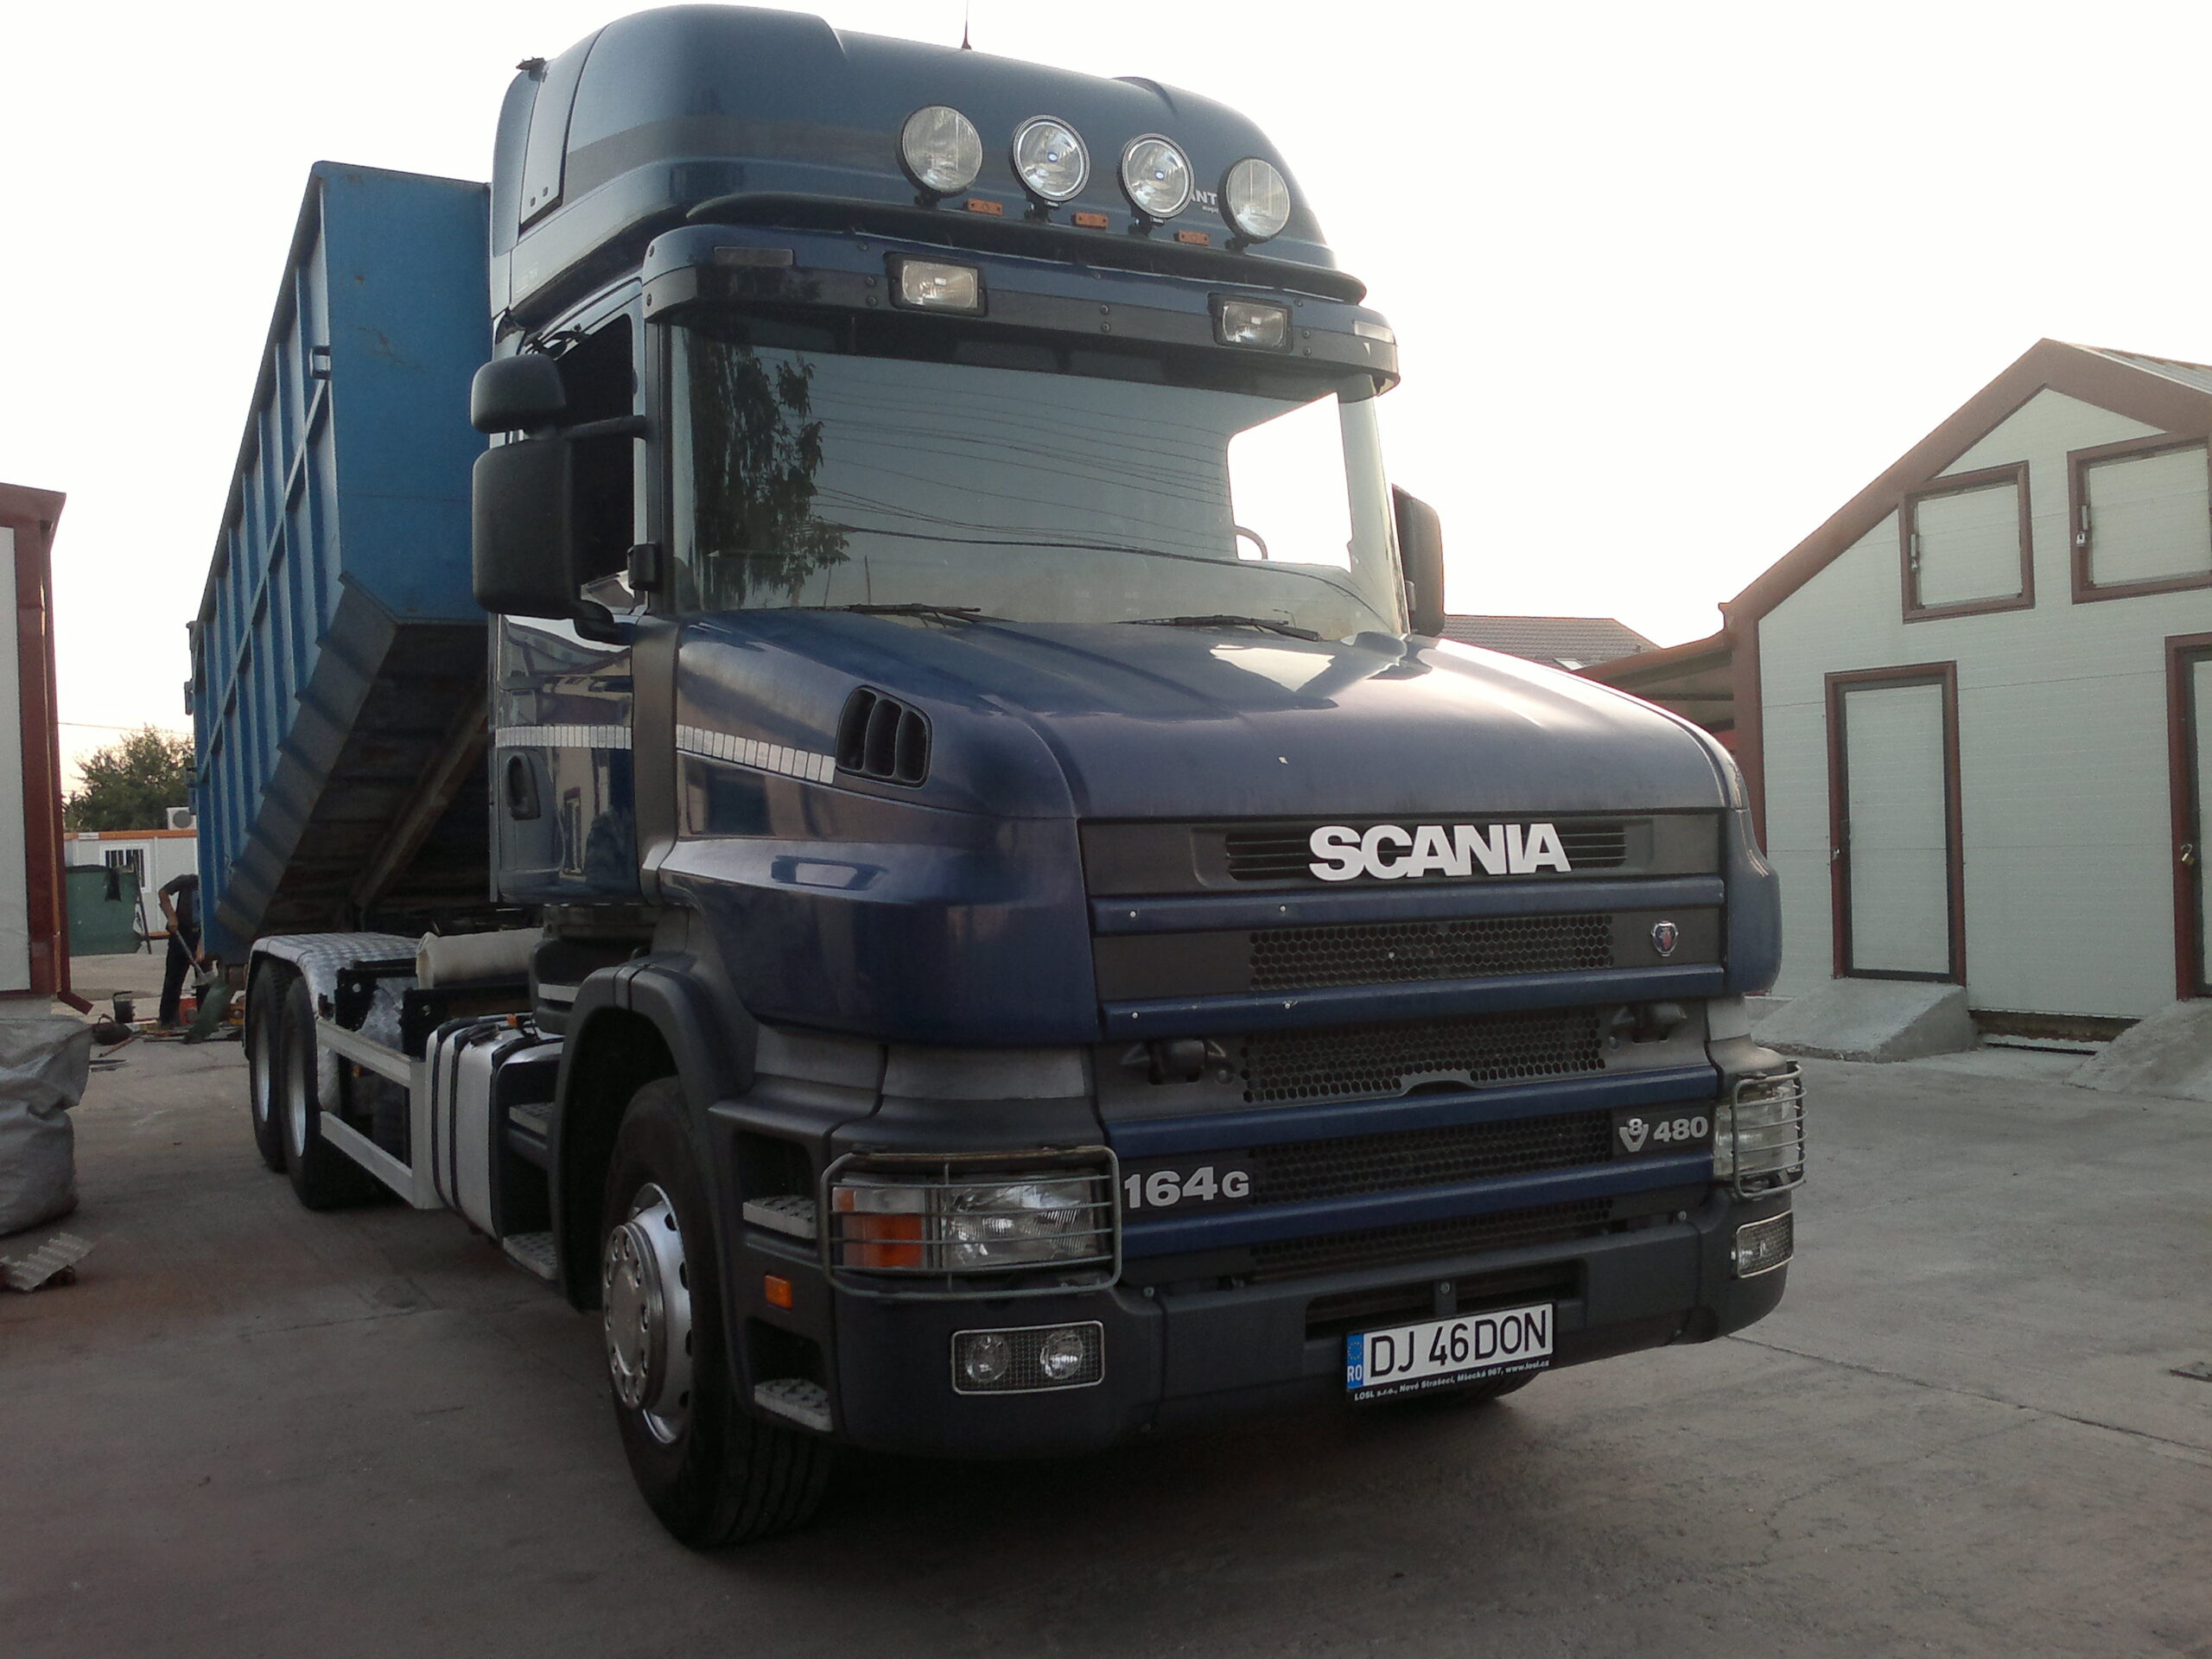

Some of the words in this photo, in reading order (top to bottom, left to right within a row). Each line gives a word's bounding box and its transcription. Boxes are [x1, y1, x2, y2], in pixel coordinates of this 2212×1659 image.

[1309, 823, 1572, 881] SCANIA
[1653, 1116, 1708, 1141] 480
[1370, 1331, 1414, 1377] DJ
[1347, 1365, 1363, 1382] RO
